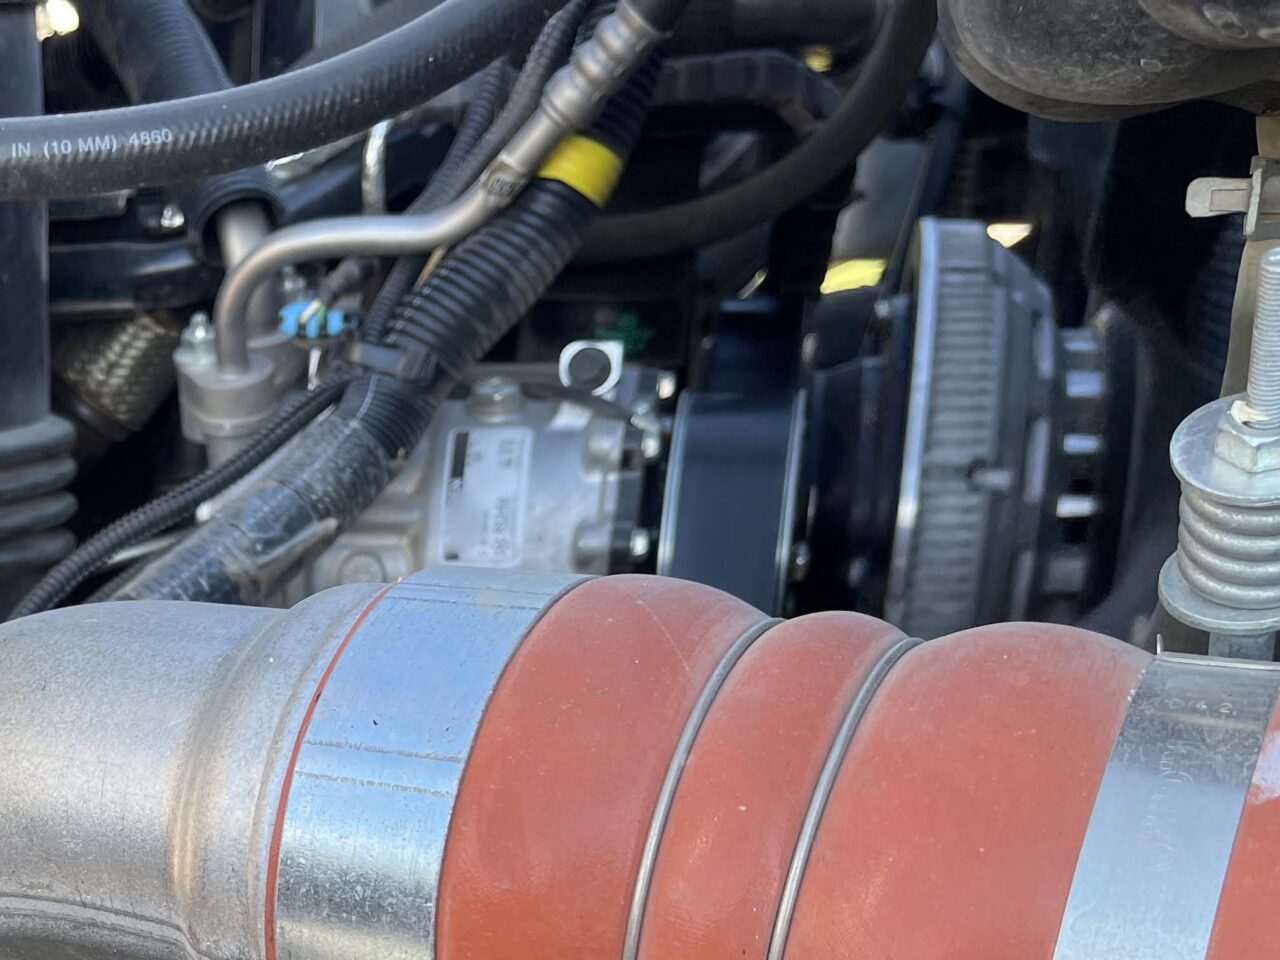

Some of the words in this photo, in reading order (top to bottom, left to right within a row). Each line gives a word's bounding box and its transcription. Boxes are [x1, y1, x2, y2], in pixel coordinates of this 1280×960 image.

[11, 141, 32, 158] IN
[43, 139, 72, 159] (10
[78, 135, 118, 154] MM)
[128, 128, 173, 147] 4860
